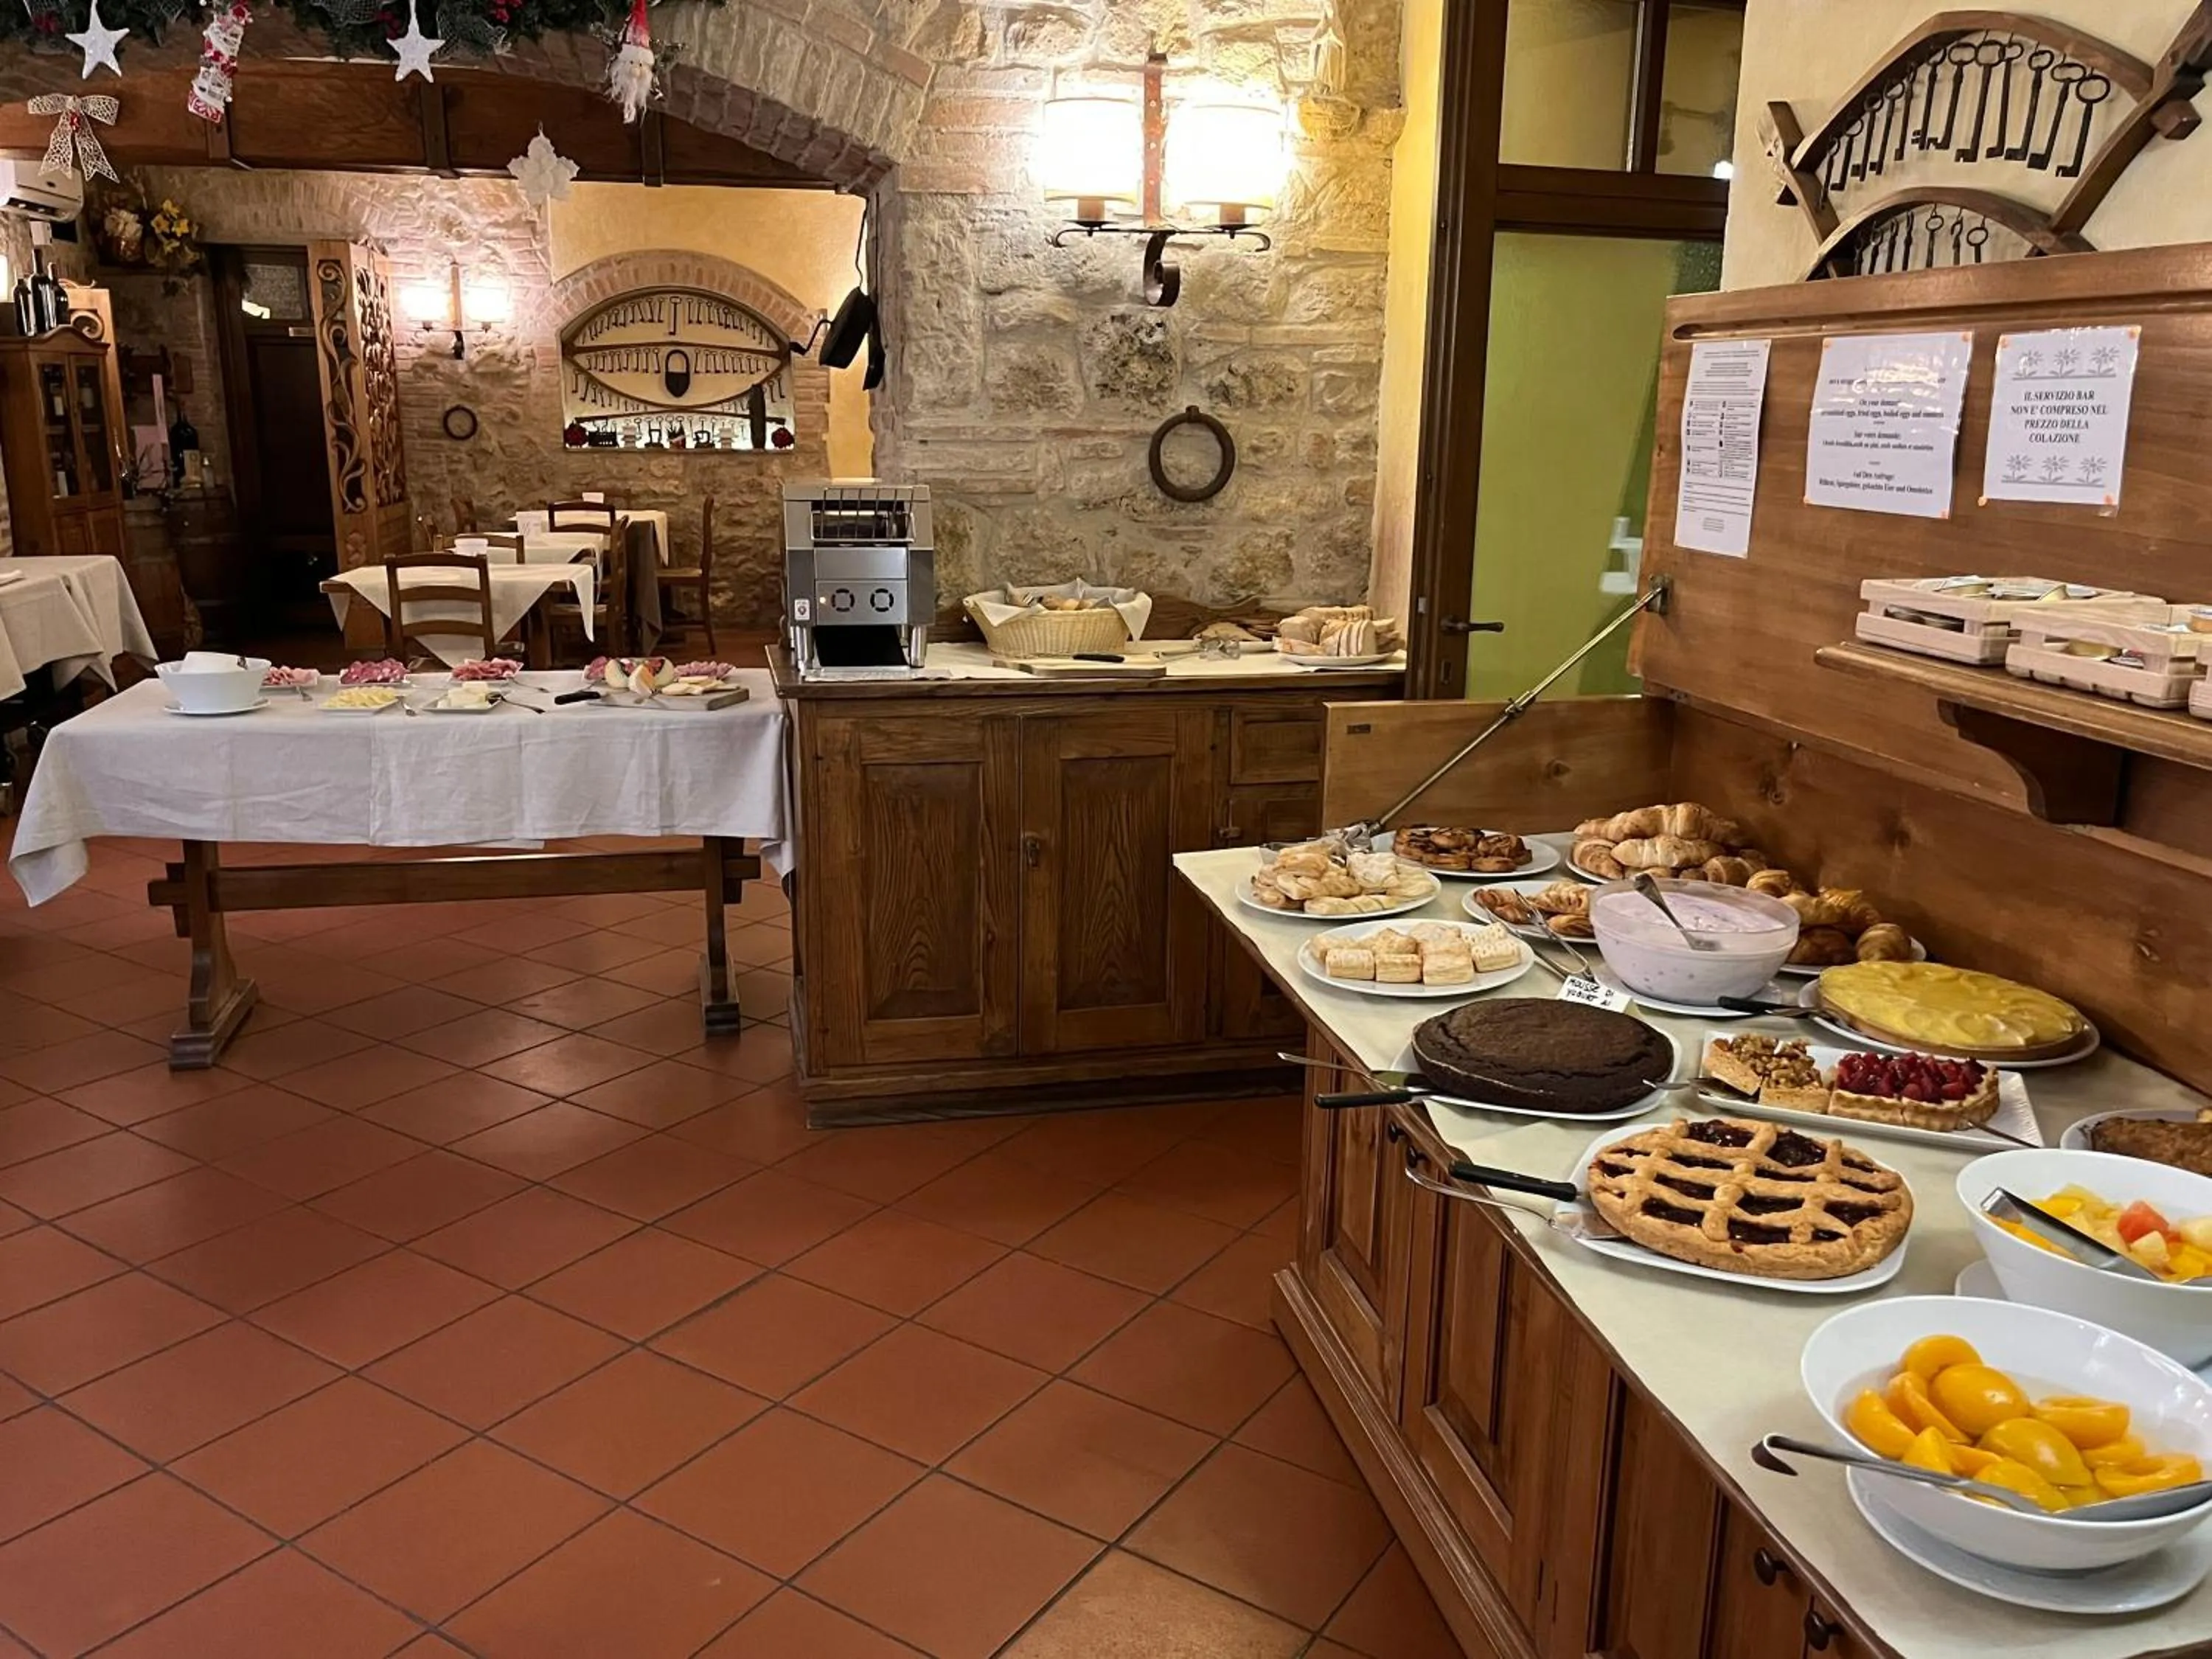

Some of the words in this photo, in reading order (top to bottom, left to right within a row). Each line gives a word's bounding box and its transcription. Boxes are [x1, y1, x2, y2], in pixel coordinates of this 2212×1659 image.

[2024, 392, 2032, 401] IL
[2034, 391, 2075, 401] SERVIZIO
[2076, 390, 2095, 400] BAR
[2011, 405, 2028, 414] NON
[2039, 405, 2089, 414] COMPRESO
[2090, 404, 2108, 414] NEL
[2024, 419, 2058, 429] PREZZO
[2059, 419, 2089, 429] DELLA
[2028, 433, 2080, 443] COLAZIONE
